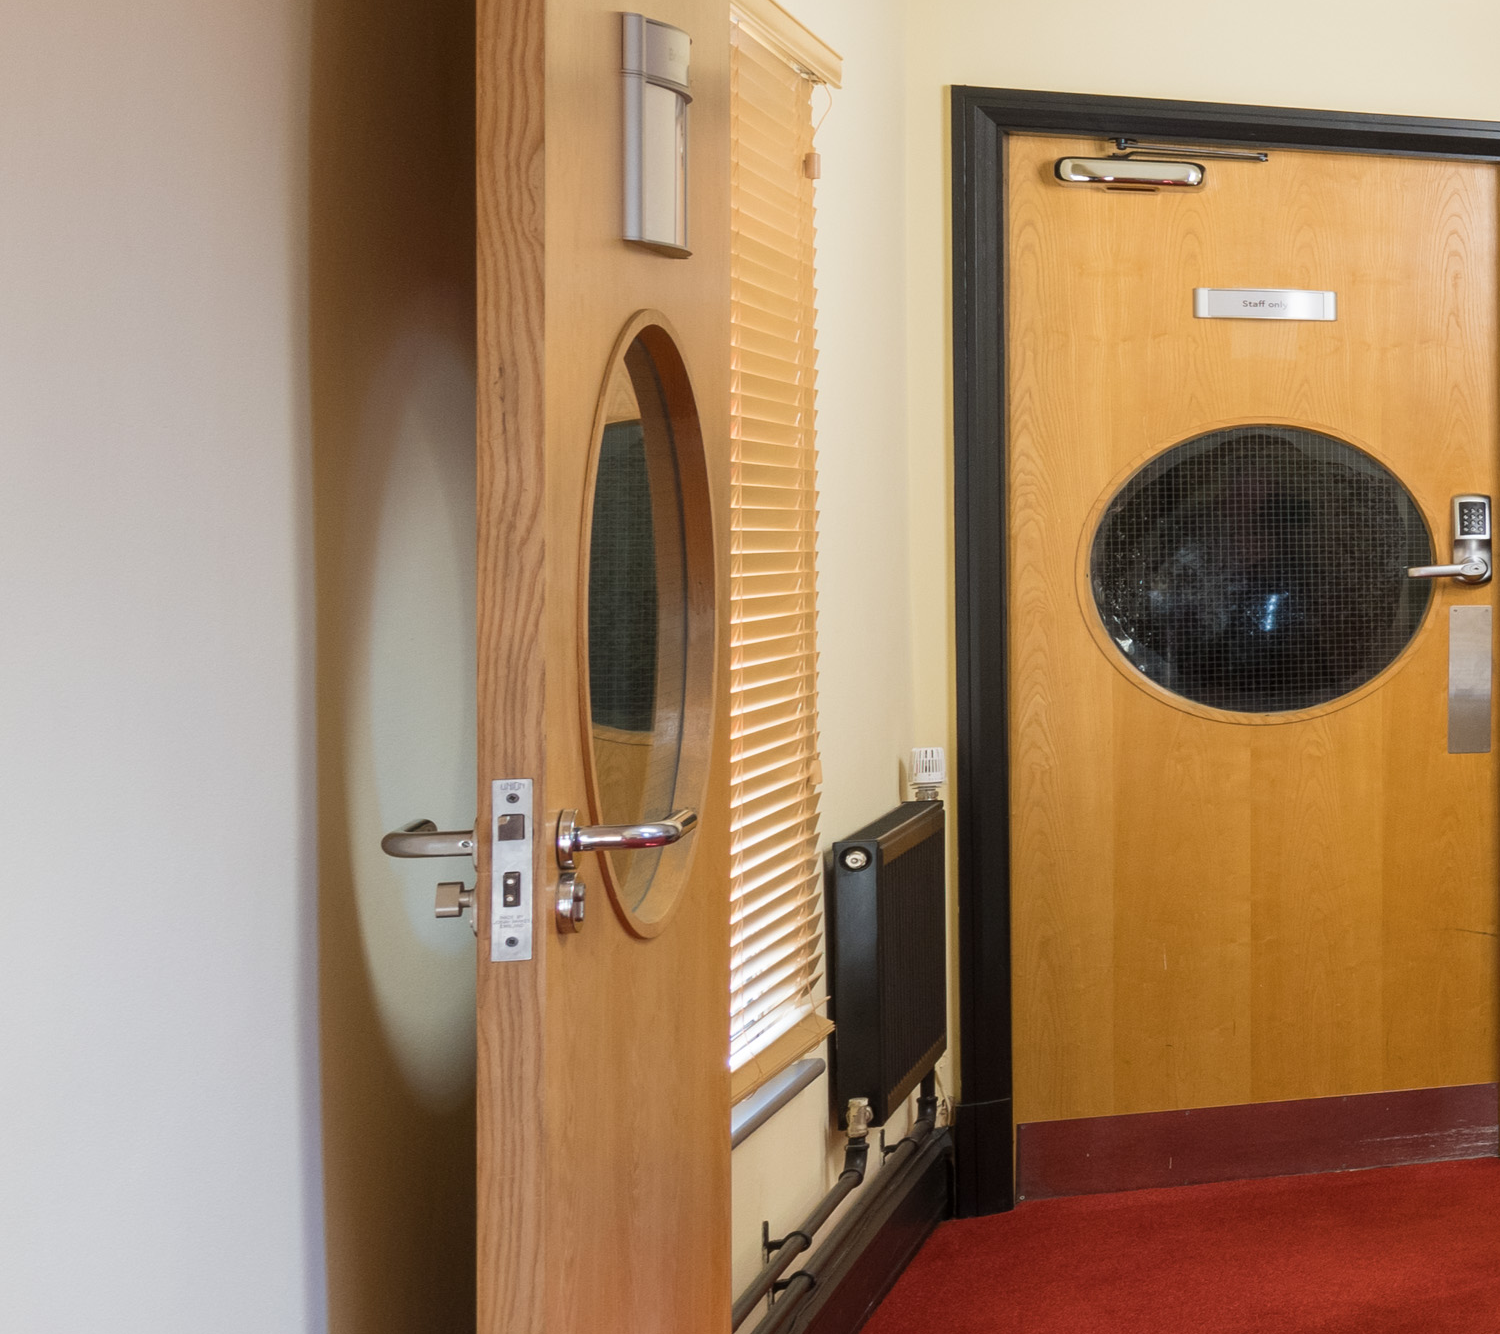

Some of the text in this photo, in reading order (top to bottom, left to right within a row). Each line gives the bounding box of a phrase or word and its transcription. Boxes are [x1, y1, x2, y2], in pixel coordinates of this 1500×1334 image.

[1242, 299, 1288, 310] Staff only
[500, 781, 525, 791] UNION
